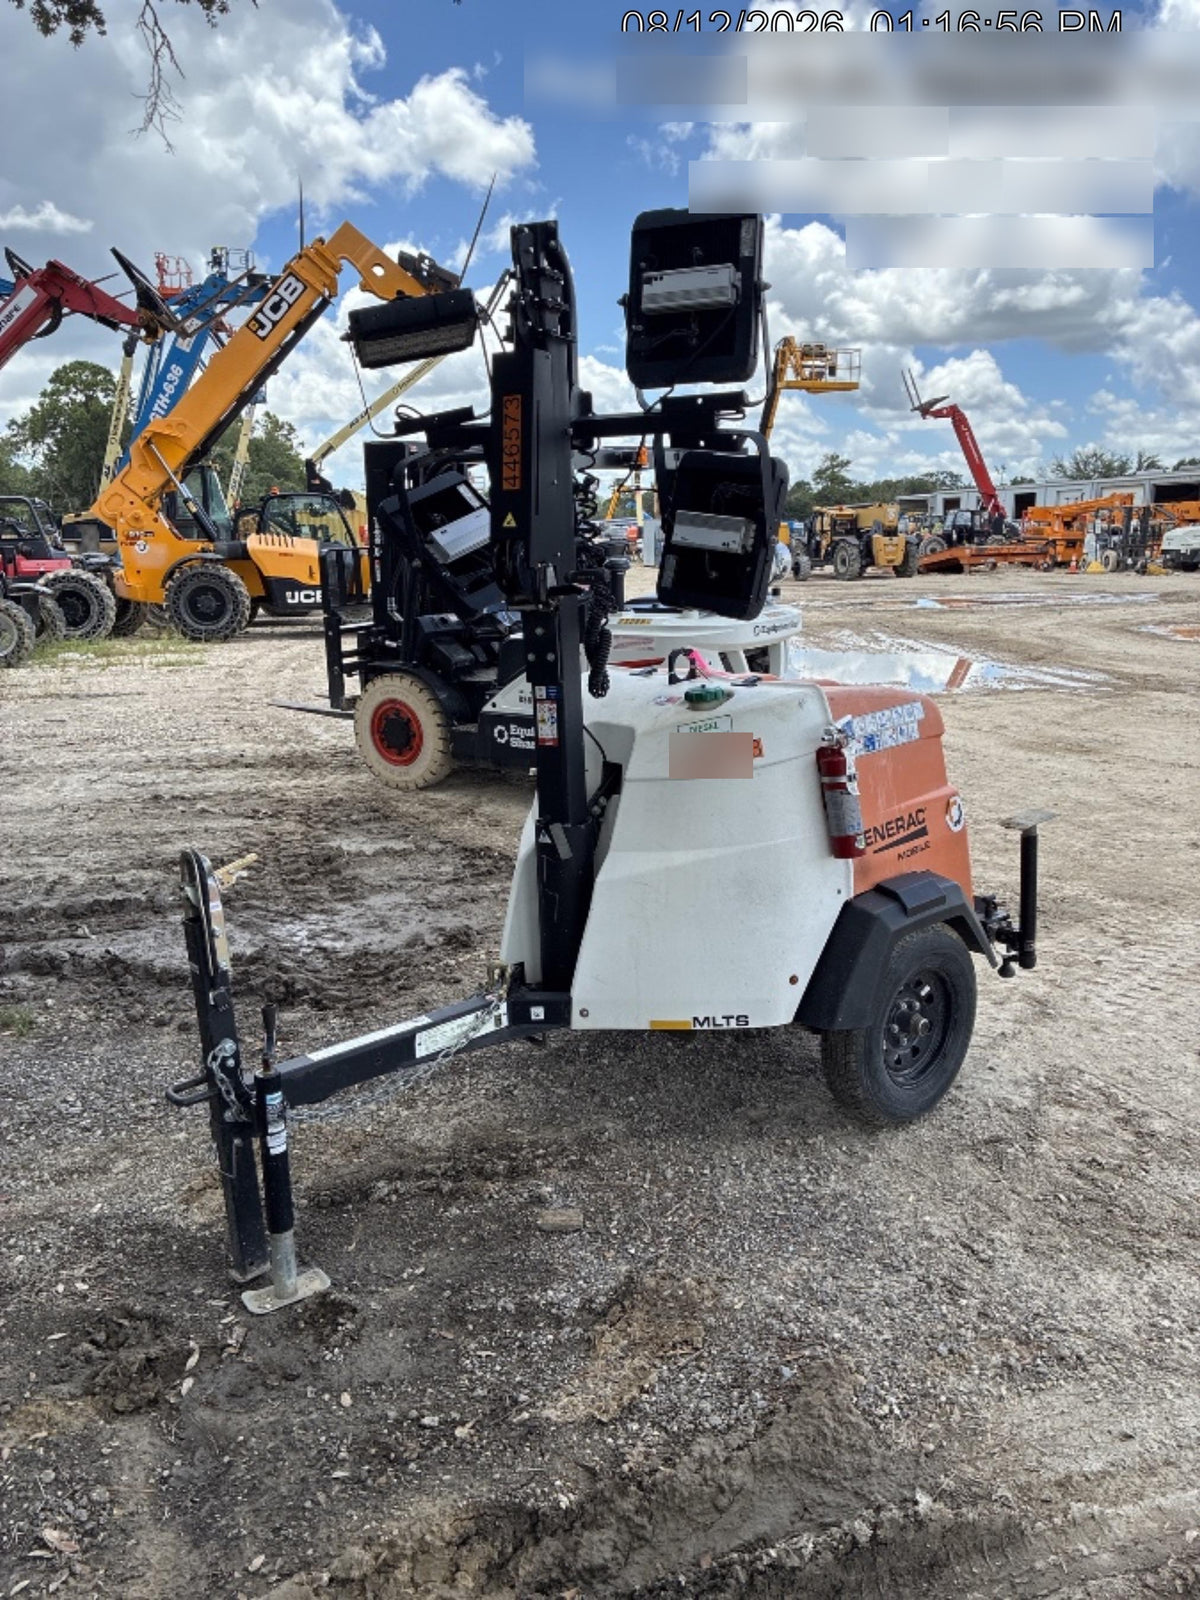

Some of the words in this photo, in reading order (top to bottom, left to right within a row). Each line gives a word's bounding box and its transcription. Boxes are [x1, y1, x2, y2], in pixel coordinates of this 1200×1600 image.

[255, 274, 305, 337] JCB
[504, 397, 520, 487] 446573
[859, 807, 927, 848] ENERAC
